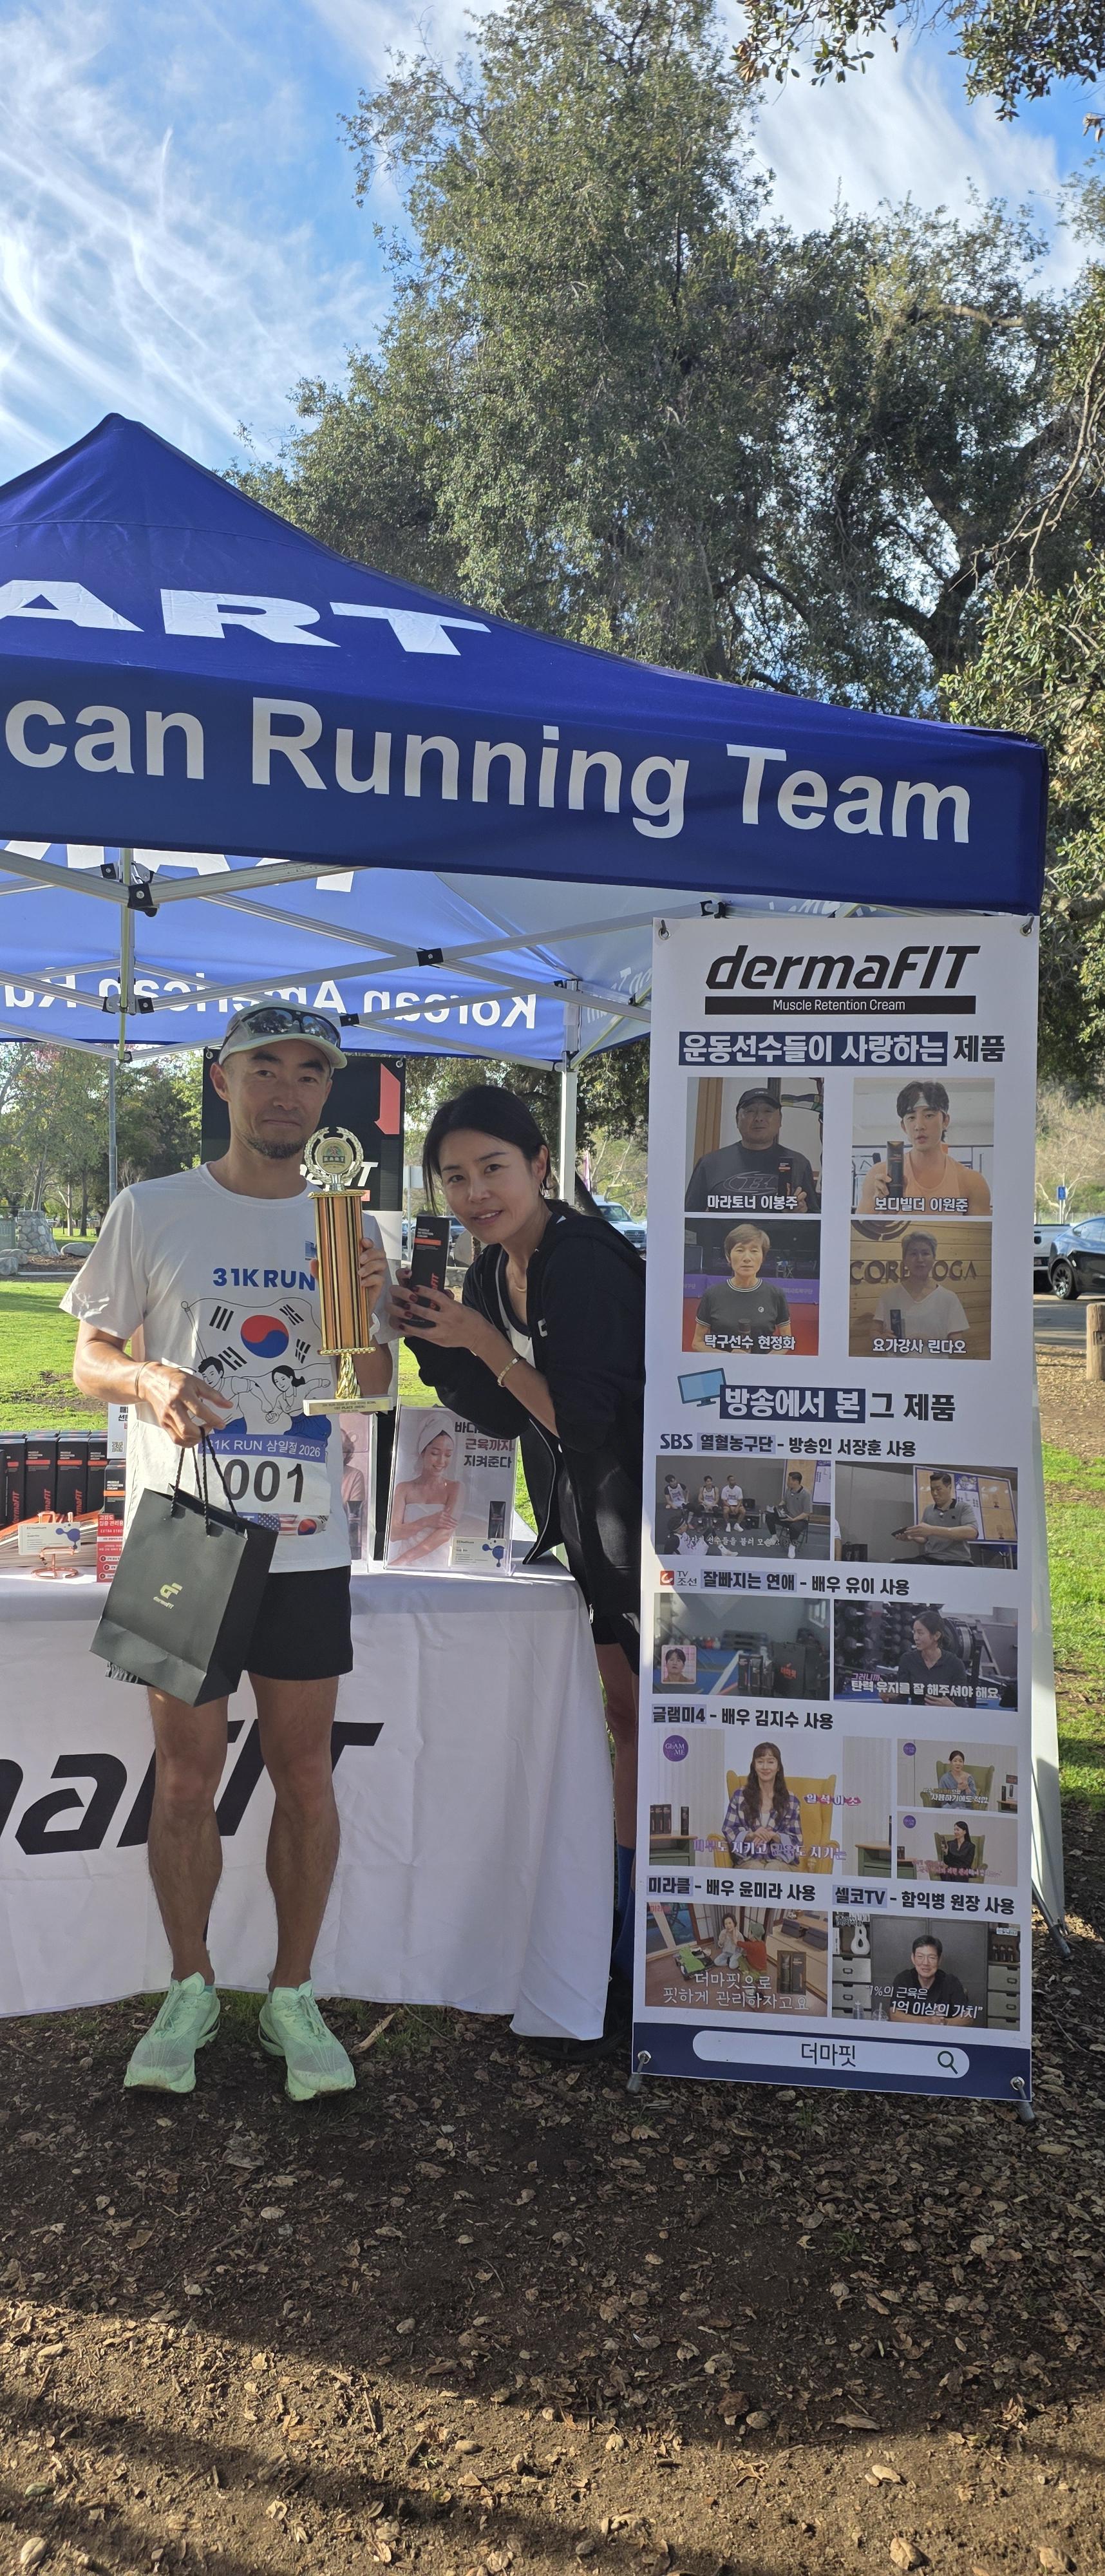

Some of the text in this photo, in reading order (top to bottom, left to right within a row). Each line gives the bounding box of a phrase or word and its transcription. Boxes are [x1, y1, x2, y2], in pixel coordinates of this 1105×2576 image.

[252, 697, 689, 838] Running
[726, 744, 970, 843] Team
[706, 945, 981, 989] dermaFIT
[773, 999, 905, 1010] Muscle Retention Cream
[683, 1035, 1006, 1063] 운동선수들이 사랑하는 제품
[707, 1195, 798, 1210] 마라토너 이봉주
[875, 1197, 968, 1212] 보디빌더 이원준
[212, 1268, 315, 1291] 31K RUN
[932, 1260, 977, 1282] OGA
[704, 1334, 795, 1350] 탁구선수 현정화
[873, 1338, 966, 1354] 요가강사 린다오
[725, 1388, 956, 1421] 방송에서 본 그 제품
[234, 1440, 262, 1451] RUN
[267, 1440, 298, 1454] 삼일절
[298, 1444, 320, 1457] 2026
[466, 1438, 512, 1451] 근육까지
[660, 1434, 693, 1449] SBS
[701, 1434, 773, 1452] 열혈농구단
[789, 1437, 832, 1455] 방송인
[837, 1439, 882, 1457] 서장훈
[887, 1441, 916, 1457] 사용
[464, 1455, 512, 1468] 지켜준다
[223, 1459, 303, 1502] 001
[677, 1578, 697, 1586] 조선
[704, 1571, 761, 1589] 잘빠지는
[766, 1573, 795, 1590] 연애
[812, 1576, 840, 1593] 배우
[846, 1577, 874, 1594] 유이
[880, 1579, 909, 1596] 사용
[851, 1680, 999, 1698] 탄력 유지를 잘 해주셔야 해요
[653, 1706, 705, 1723] 글램미4
[722, 1709, 750, 1725] 배우
[755, 1710, 798, 1728] 김지수
[804, 1712, 833, 1730] 사용
[732, 1841, 767, 1855] 지키고
[648, 1877, 690, 1894] 미라클
[706, 1879, 734, 1896] 배우
[739, 1881, 782, 1900] 윤미라
[787, 1884, 816, 1901] 사용
[835, 1887, 885, 1904] 셀코TV
[902, 1891, 945, 1910] 함익병
[951, 1895, 980, 1912] 원장
[985, 1897, 1014, 1915] 사용
[695, 1972, 772, 1990] 더마핏으로
[663, 1987, 809, 2011] 핏하게 관리하자고요
[896, 1987, 928, 2000] 근육은
[891, 2001, 909, 2014] 1억
[912, 2002, 949, 2017] 이상의
[802, 2043, 856, 2067] 더마핏
